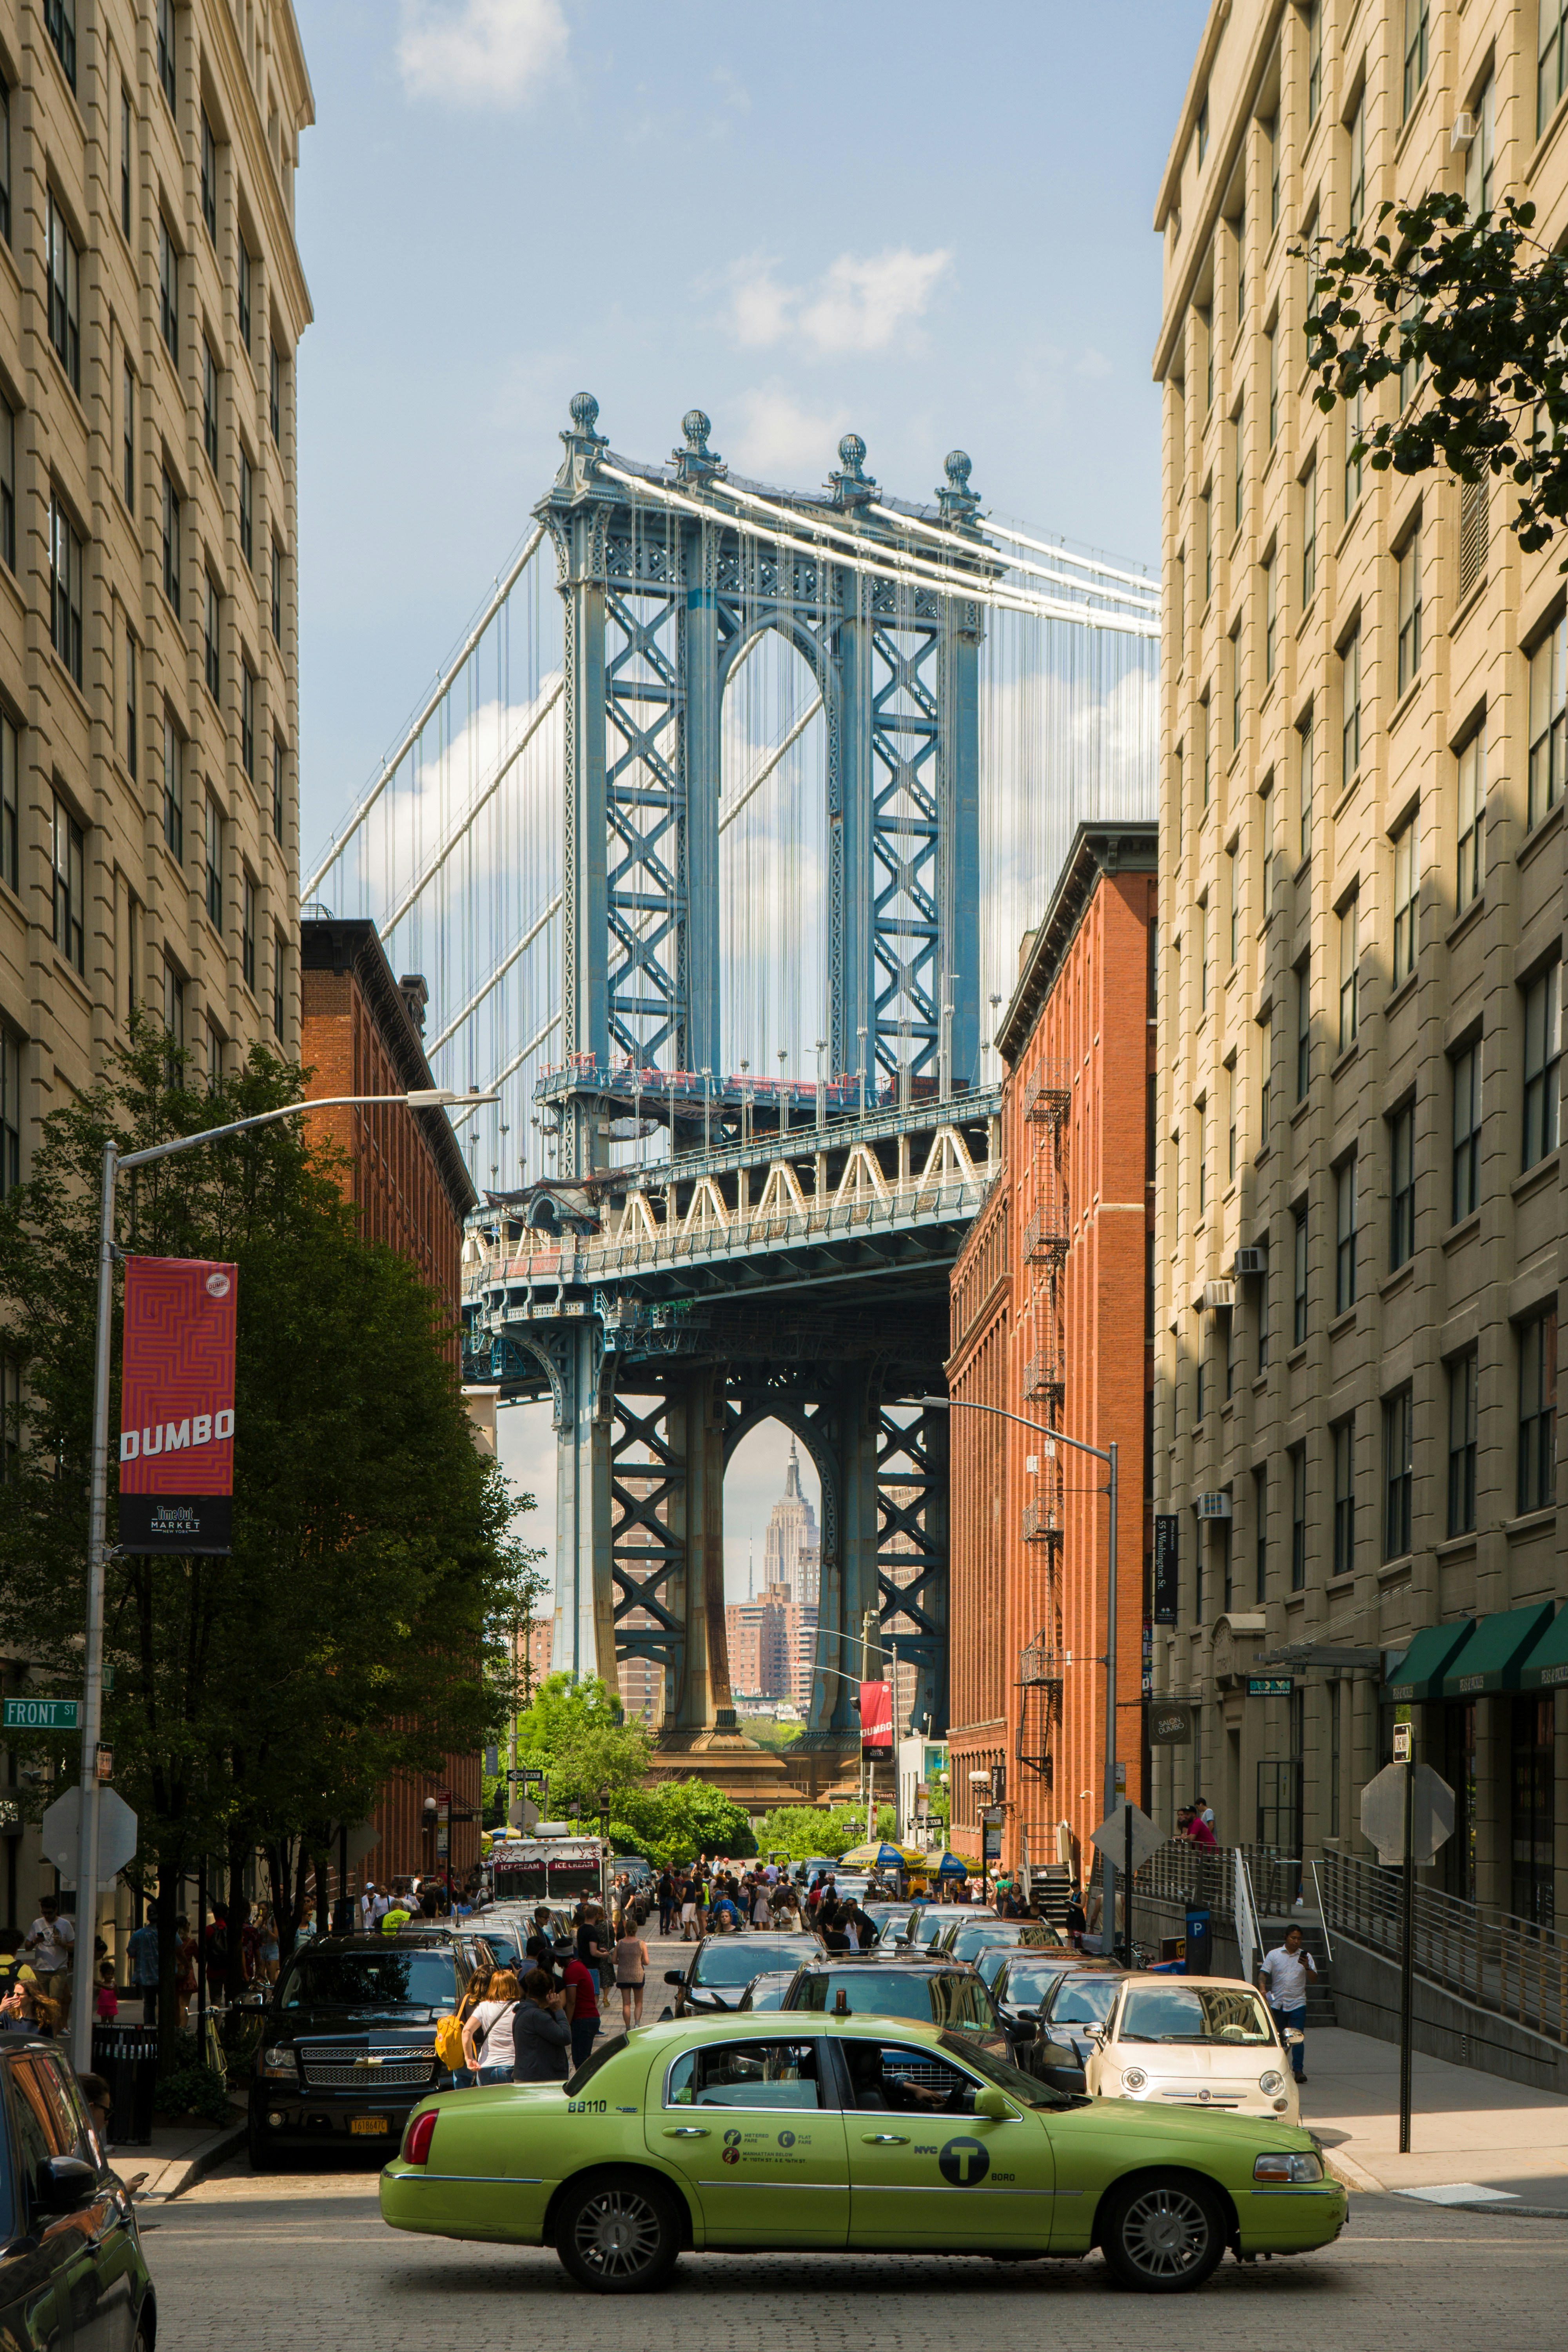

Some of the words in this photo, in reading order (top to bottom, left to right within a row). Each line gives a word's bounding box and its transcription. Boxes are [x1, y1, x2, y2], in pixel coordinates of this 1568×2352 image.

[209, 1281, 227, 1290] DUMBO
[120, 1409, 234, 1462] DUMBO
[1158, 1520, 1166, 1529] 55
[1156, 1532, 1167, 1577] Washington
[1158, 1579, 1166, 1589] St.
[1250, 1681, 1290, 1690] BROOKLYN
[8, 1703, 57, 1724] FRONT
[64, 1705, 75, 1715] ST
[1158, 1722, 1184, 1734] DUMBO
[1159, 1717, 1181, 1727] SALON
[860, 1722, 892, 1737] DUMBO
[1194, 1923, 1202, 1935] P
[354, 2121, 385, 2130] T618647C
[914, 2146, 938, 2154] NYC
[951, 2147, 978, 2180] T
[991, 2173, 1015, 2181] BORO
